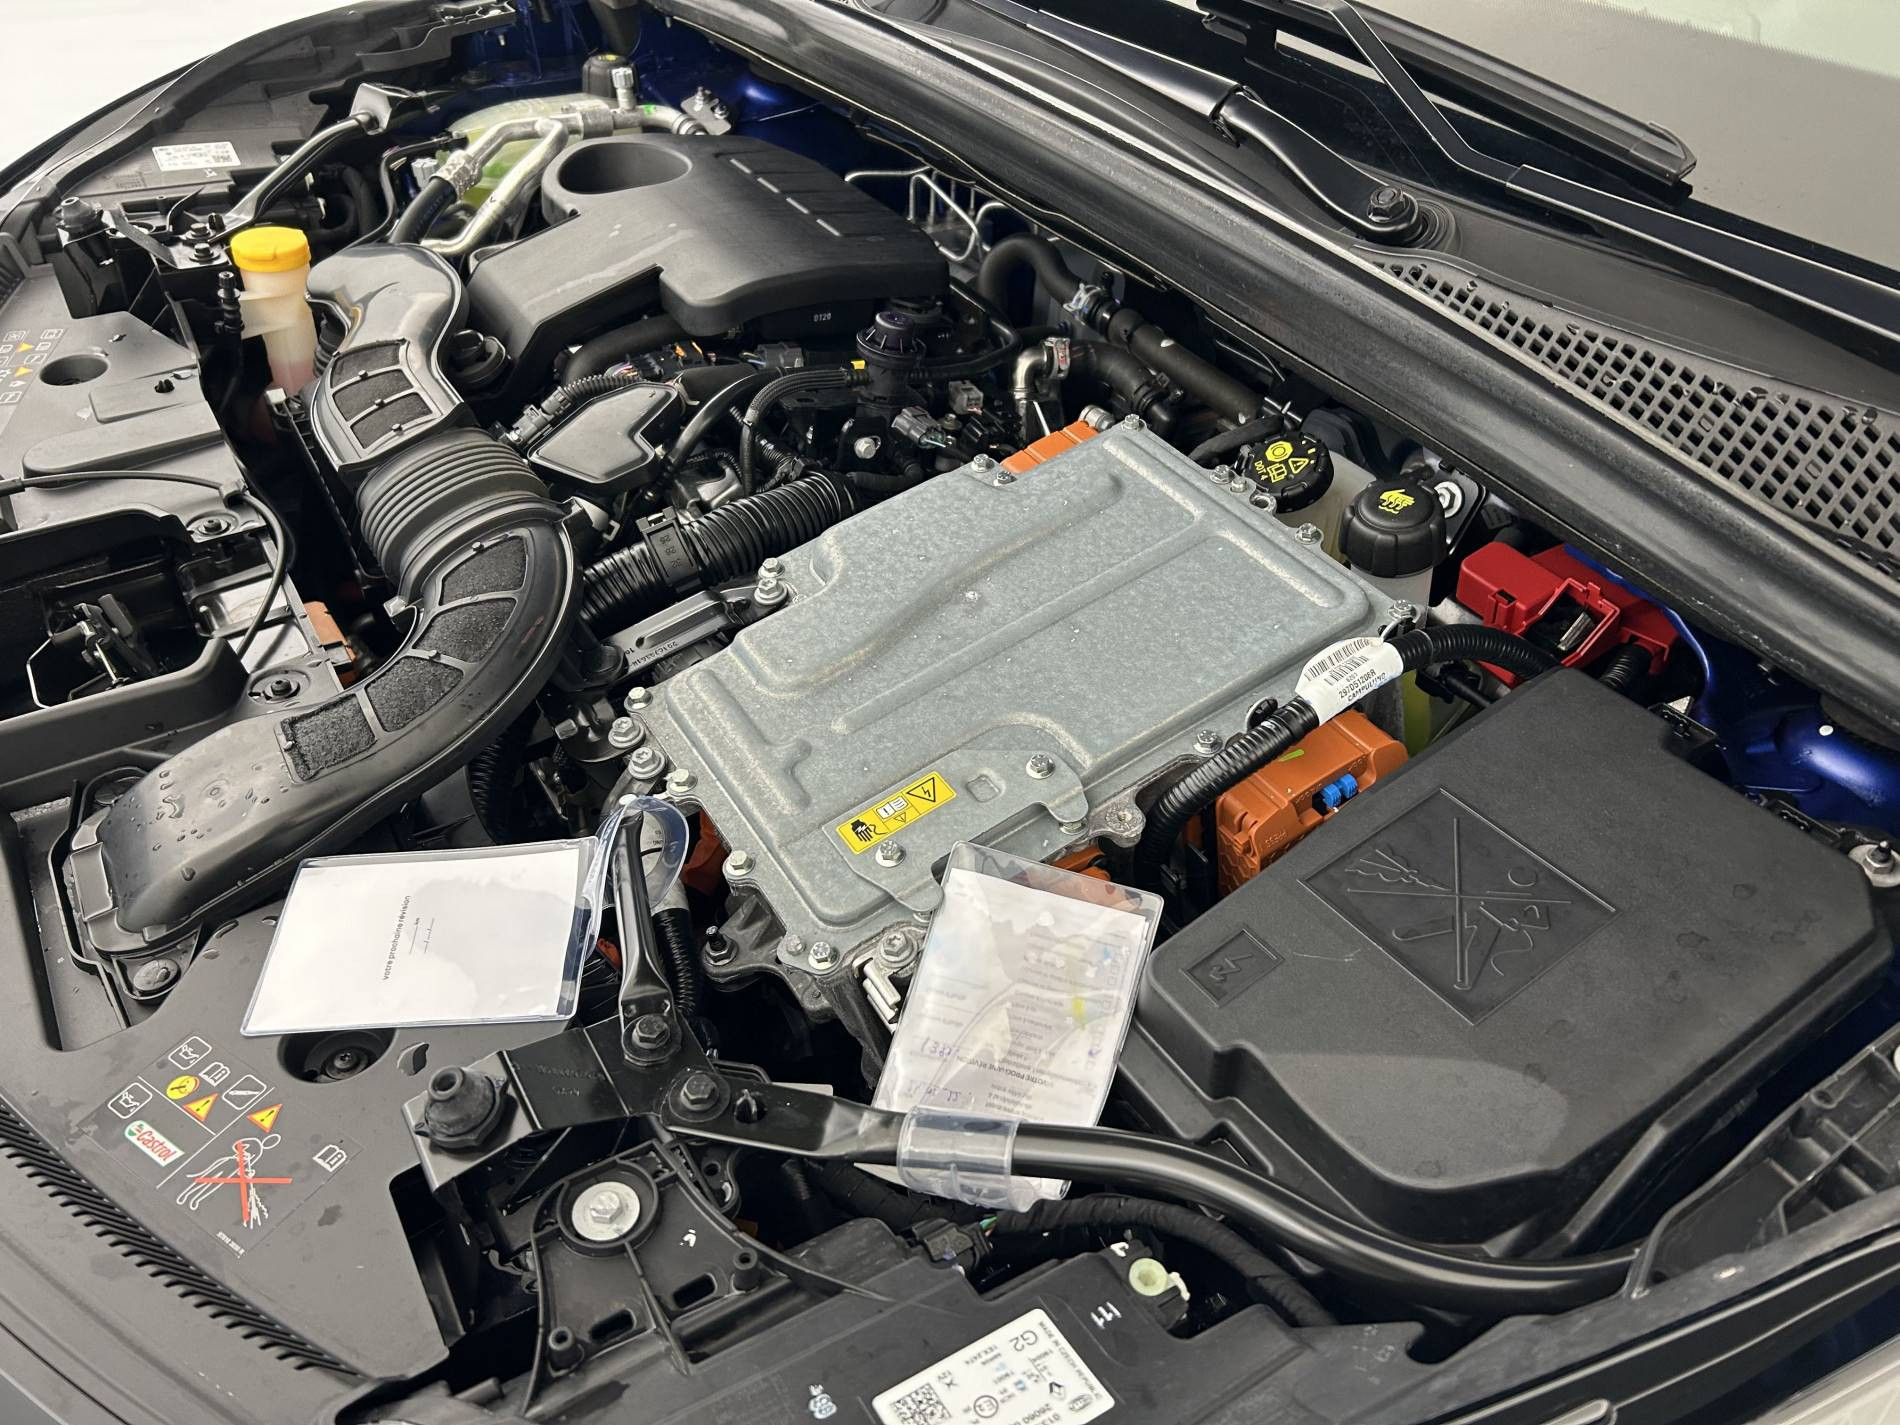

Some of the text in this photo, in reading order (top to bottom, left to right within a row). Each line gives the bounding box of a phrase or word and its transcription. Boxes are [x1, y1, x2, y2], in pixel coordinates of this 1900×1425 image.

[1254, 460, 1266, 474] DOT
[136, 1130, 177, 1161] Castrol
[1009, 1330, 1038, 1352] G2
